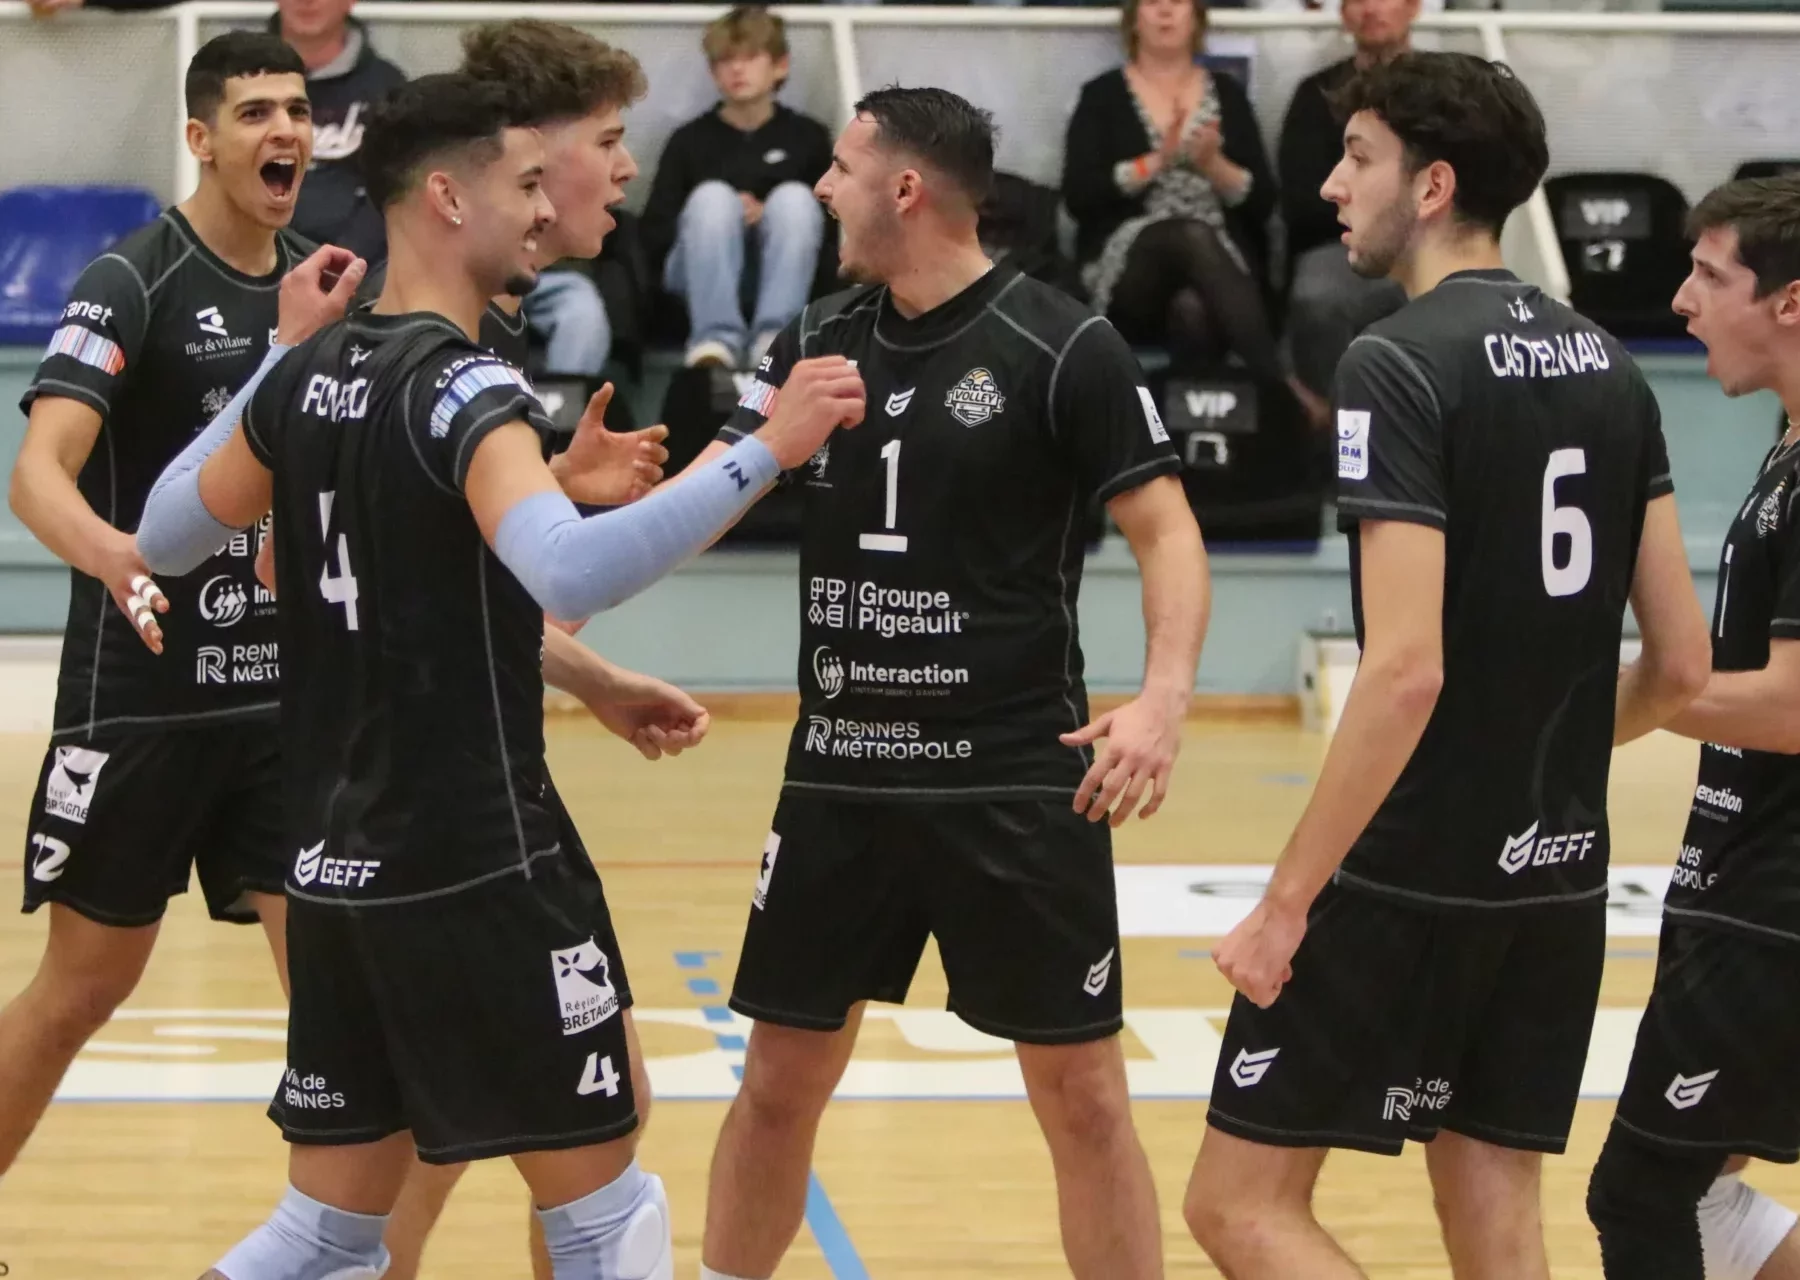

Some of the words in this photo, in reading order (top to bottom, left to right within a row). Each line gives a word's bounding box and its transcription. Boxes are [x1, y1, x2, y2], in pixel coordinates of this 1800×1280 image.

[1580, 198, 1631, 225] VIP
[60, 301, 113, 326] anet
[1484, 332, 1610, 378] CASTELNAU
[955, 390, 996, 404] VOLLEY
[1185, 389, 1237, 418] VIP
[1339, 445, 1362, 459] BM
[1339, 464, 1361, 474] OLLEY
[879, 439, 901, 529] 1
[1541, 448, 1592, 597] 6
[319, 491, 359, 631] 4
[859, 581, 950, 615] Groupe
[850, 661, 969, 683] Interaction
[1695, 784, 1743, 813] eraction
[1532, 831, 1595, 866] GEFF
[320, 857, 381, 887] GEFF
[302, 1074, 326, 1090] de
[576, 1051, 621, 1097] 4
[1427, 1078, 1449, 1092] de
